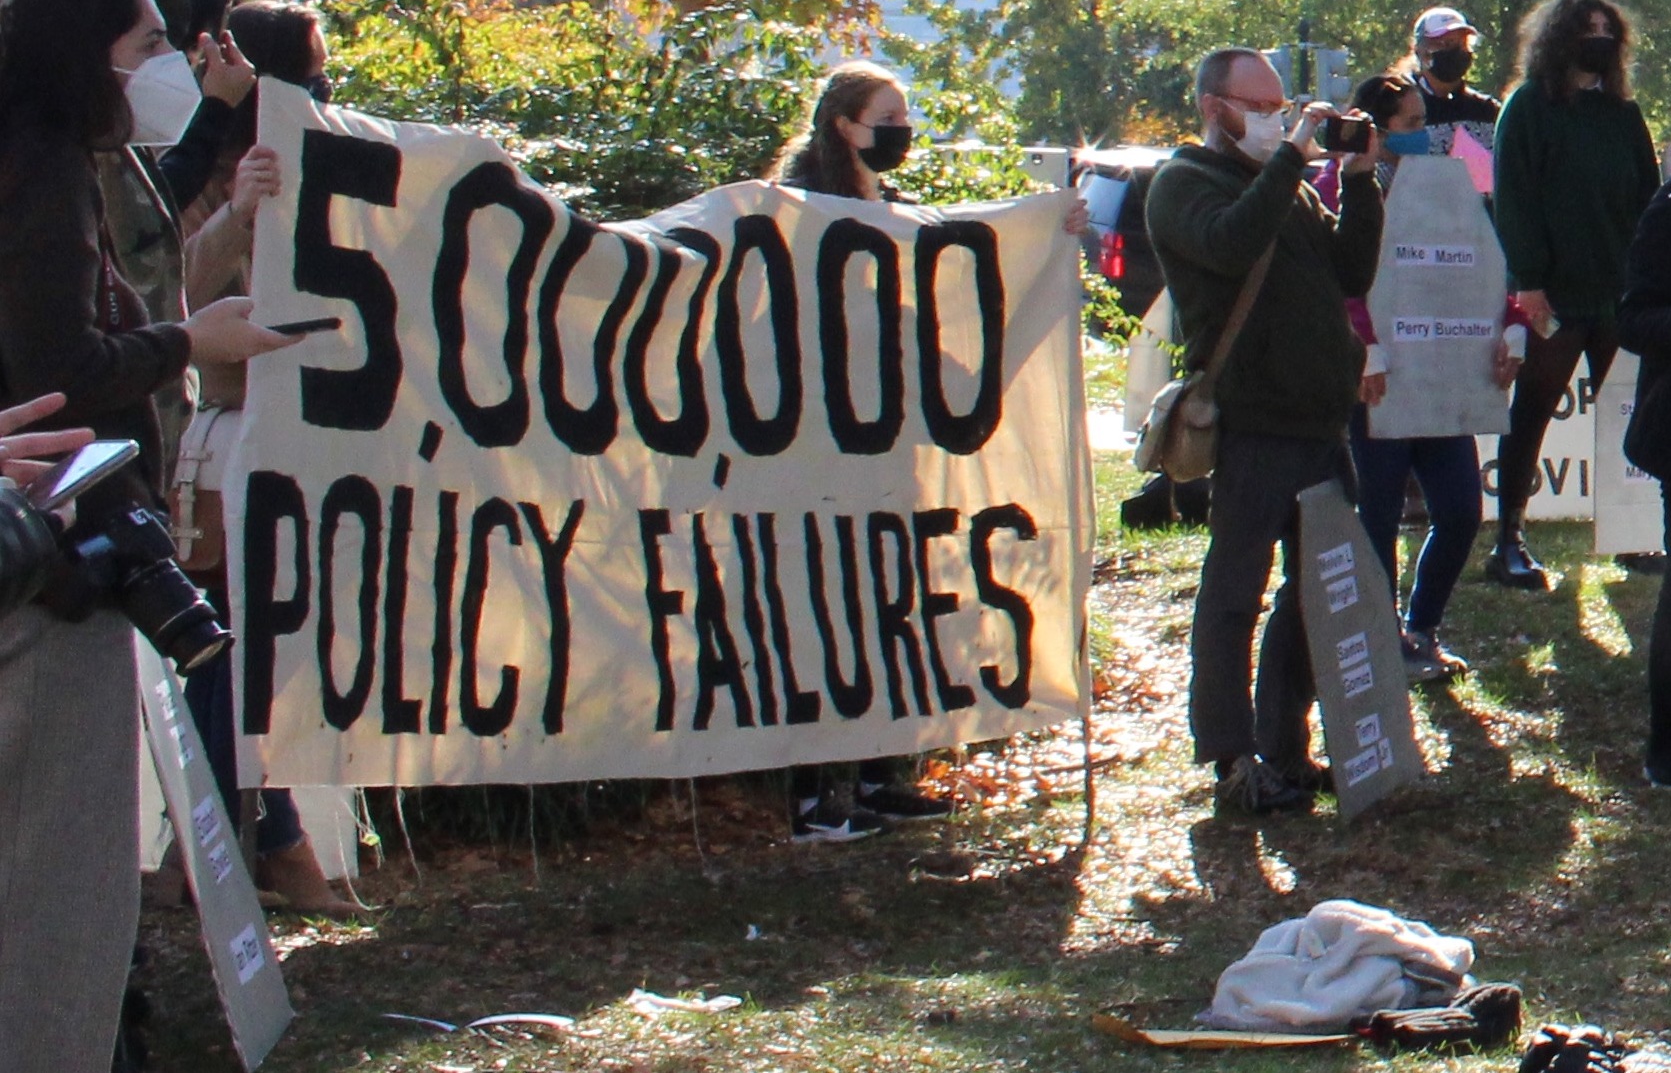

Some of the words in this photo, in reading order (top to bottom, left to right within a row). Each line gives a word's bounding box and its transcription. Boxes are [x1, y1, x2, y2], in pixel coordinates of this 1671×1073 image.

[1396, 246, 1425, 260] Mike
[1435, 250, 1474, 263] Martin
[1397, 321, 1429, 337] Perry
[1435, 322, 1492, 336] Buchalter
[1551, 378, 1596, 420] OP
[243, 469, 584, 738] POLICY
[638, 504, 1040, 734] FAILURES
